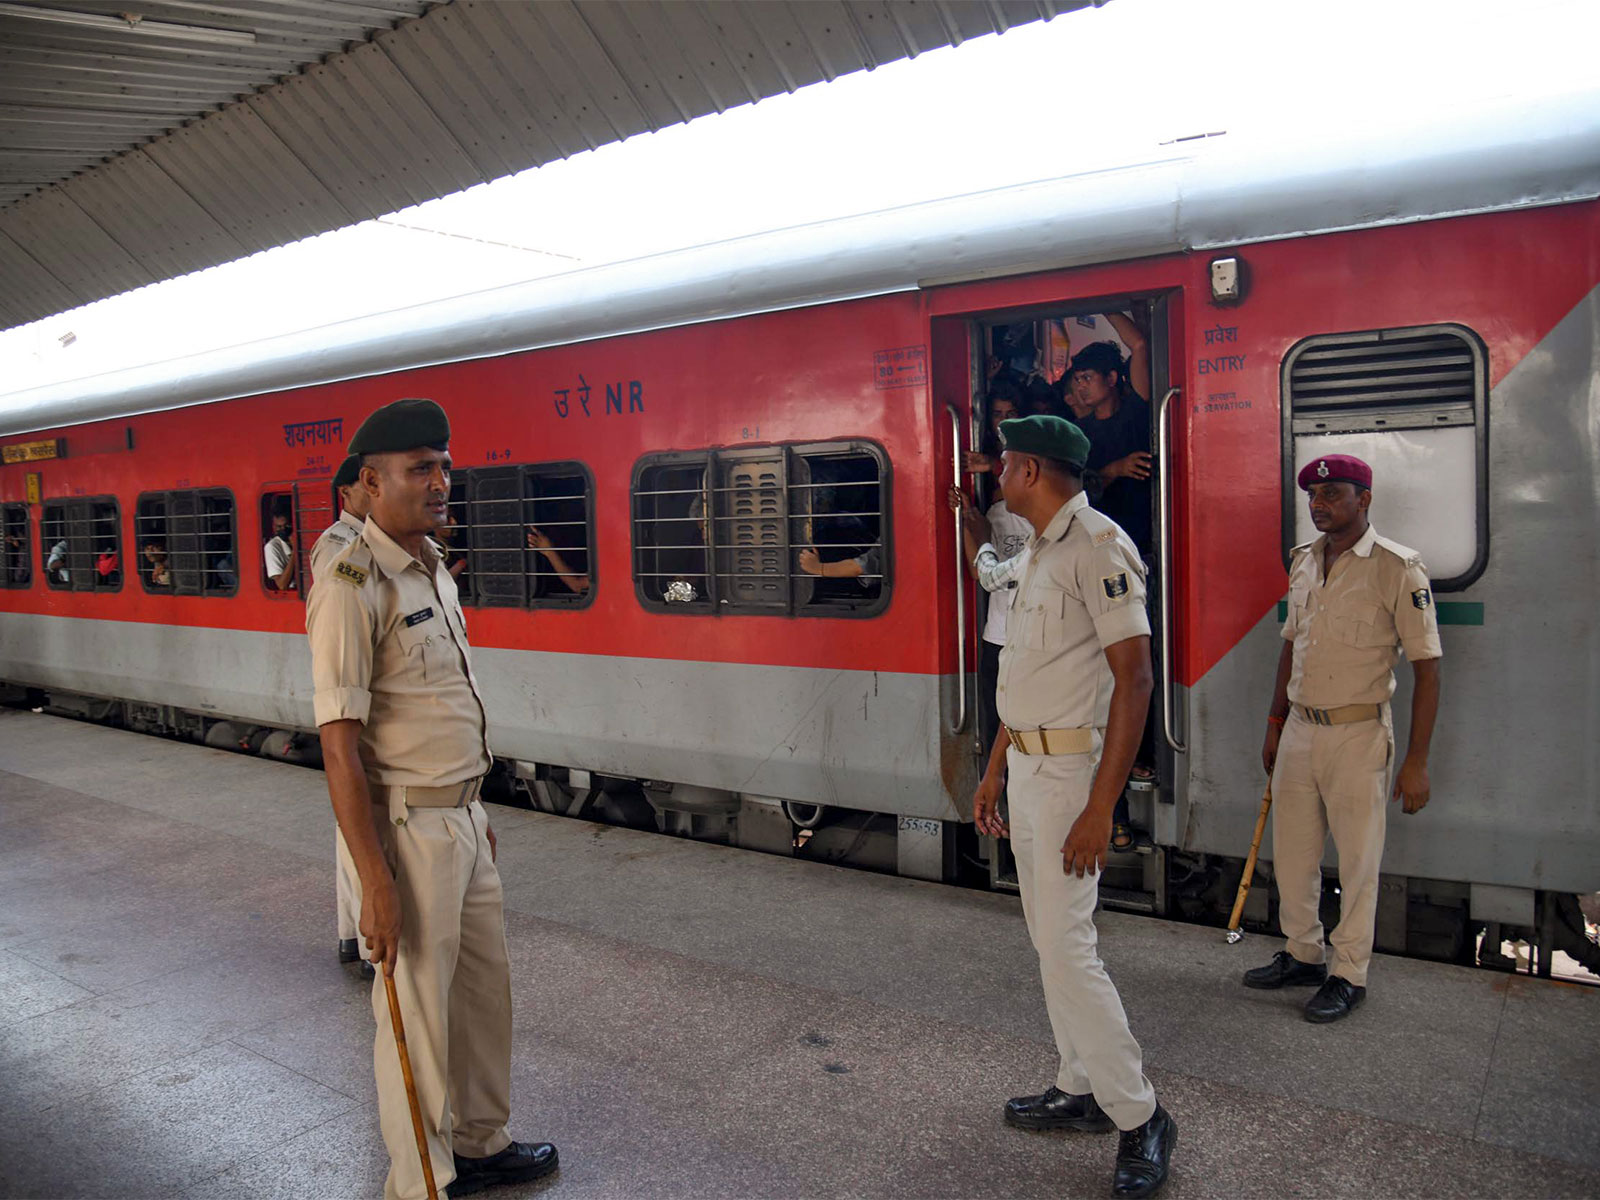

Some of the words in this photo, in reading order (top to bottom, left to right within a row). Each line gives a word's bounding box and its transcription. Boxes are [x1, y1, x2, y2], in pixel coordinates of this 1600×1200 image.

[1204, 323, 1238, 346] प्रवेश
[1198, 354, 1247, 375] ENTRY
[606, 380, 645, 415] NR
[283, 417, 344, 448] शयनयान
[486, 449, 511, 461] 16-9
